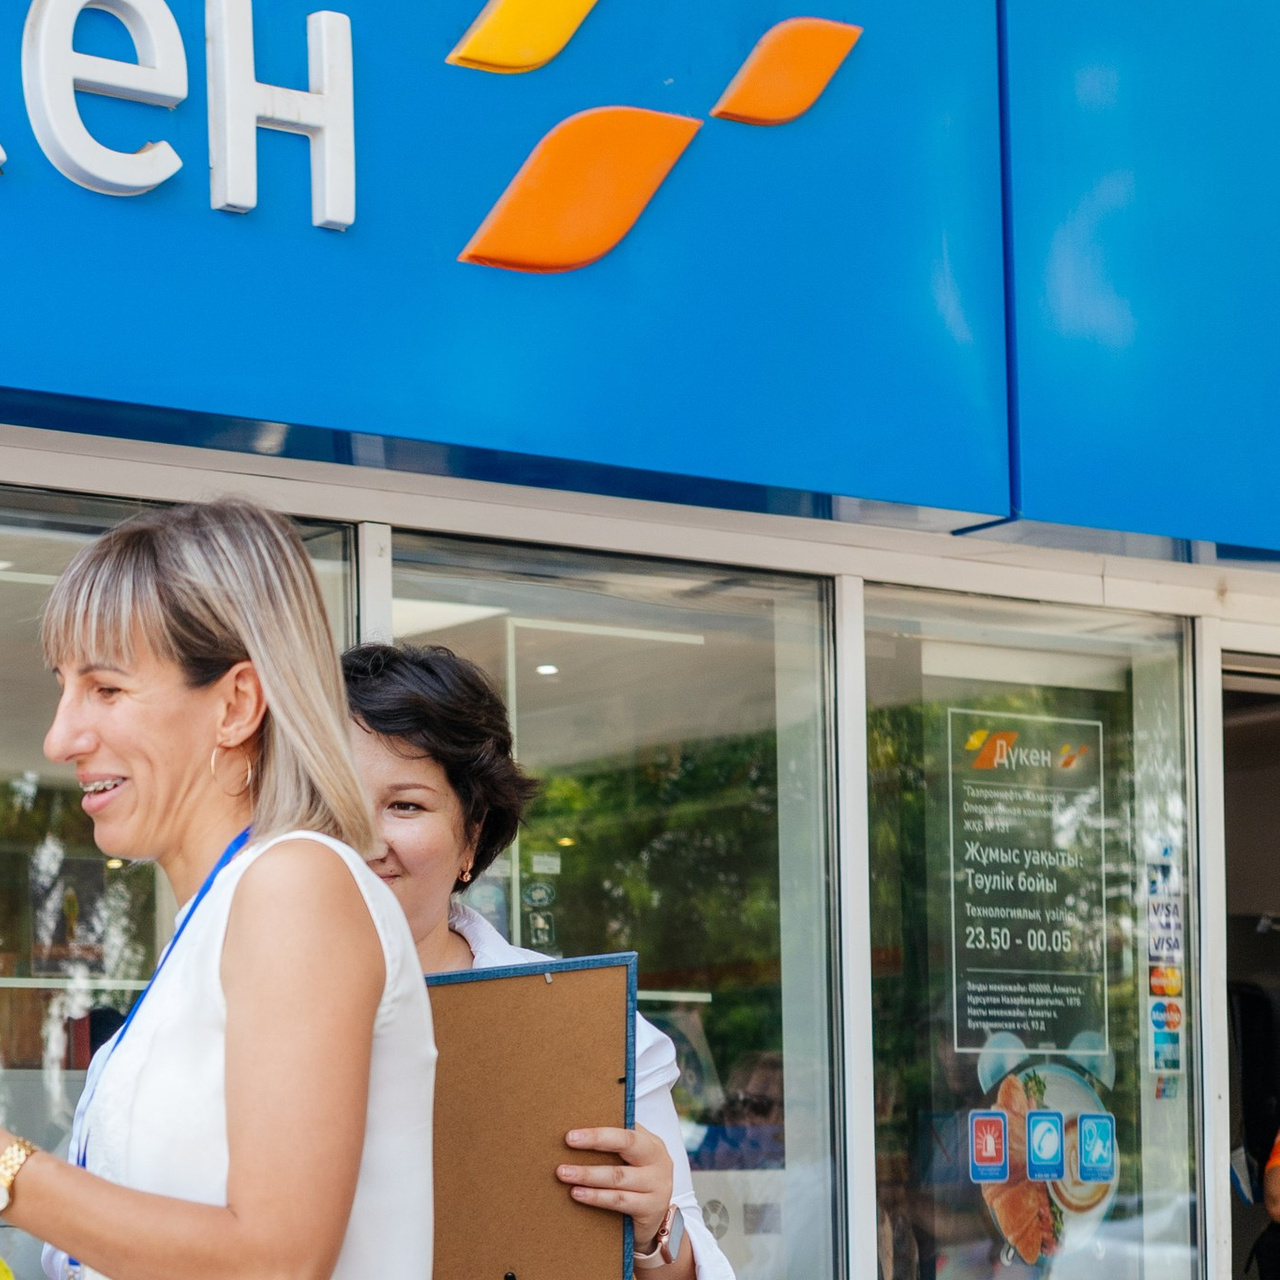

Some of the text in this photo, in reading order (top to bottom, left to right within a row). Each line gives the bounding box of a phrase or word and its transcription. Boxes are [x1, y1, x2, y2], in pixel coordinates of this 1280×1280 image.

[993, 738, 1052, 770] Дүкен
[964, 840, 1084, 870] Жұмыс уақыты:
[964, 868, 1057, 894] Тәулік бойы
[965, 902, 1042, 922] Технологиялық
[1152, 902, 1180, 918] VISA
[965, 926, 1011, 950] 23.50
[1027, 928, 1073, 953] 00.05
[1153, 935, 1180, 951] VISA
